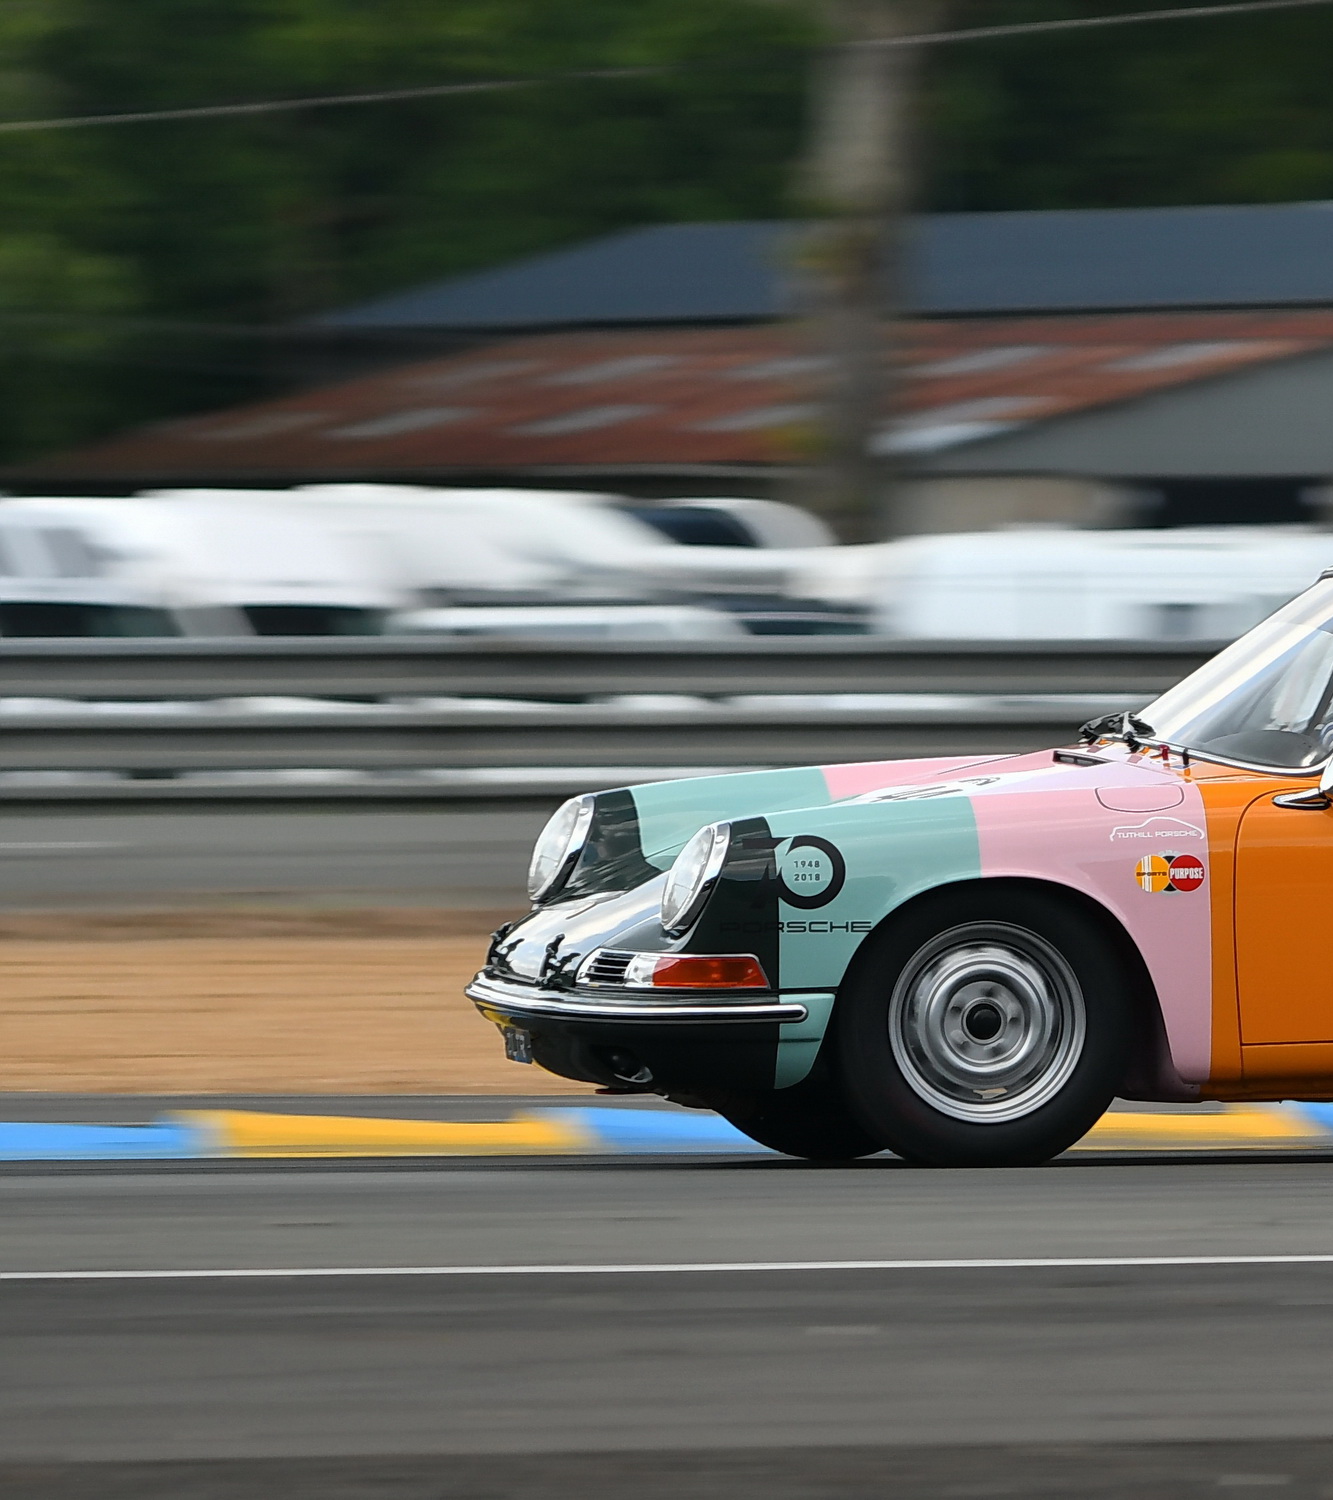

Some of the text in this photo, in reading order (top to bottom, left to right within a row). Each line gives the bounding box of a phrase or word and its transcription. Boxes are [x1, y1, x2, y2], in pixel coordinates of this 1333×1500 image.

[793, 860, 820, 868] 1948
[793, 873, 821, 882] 2018
[1169, 867, 1204, 879] PURPOSE
